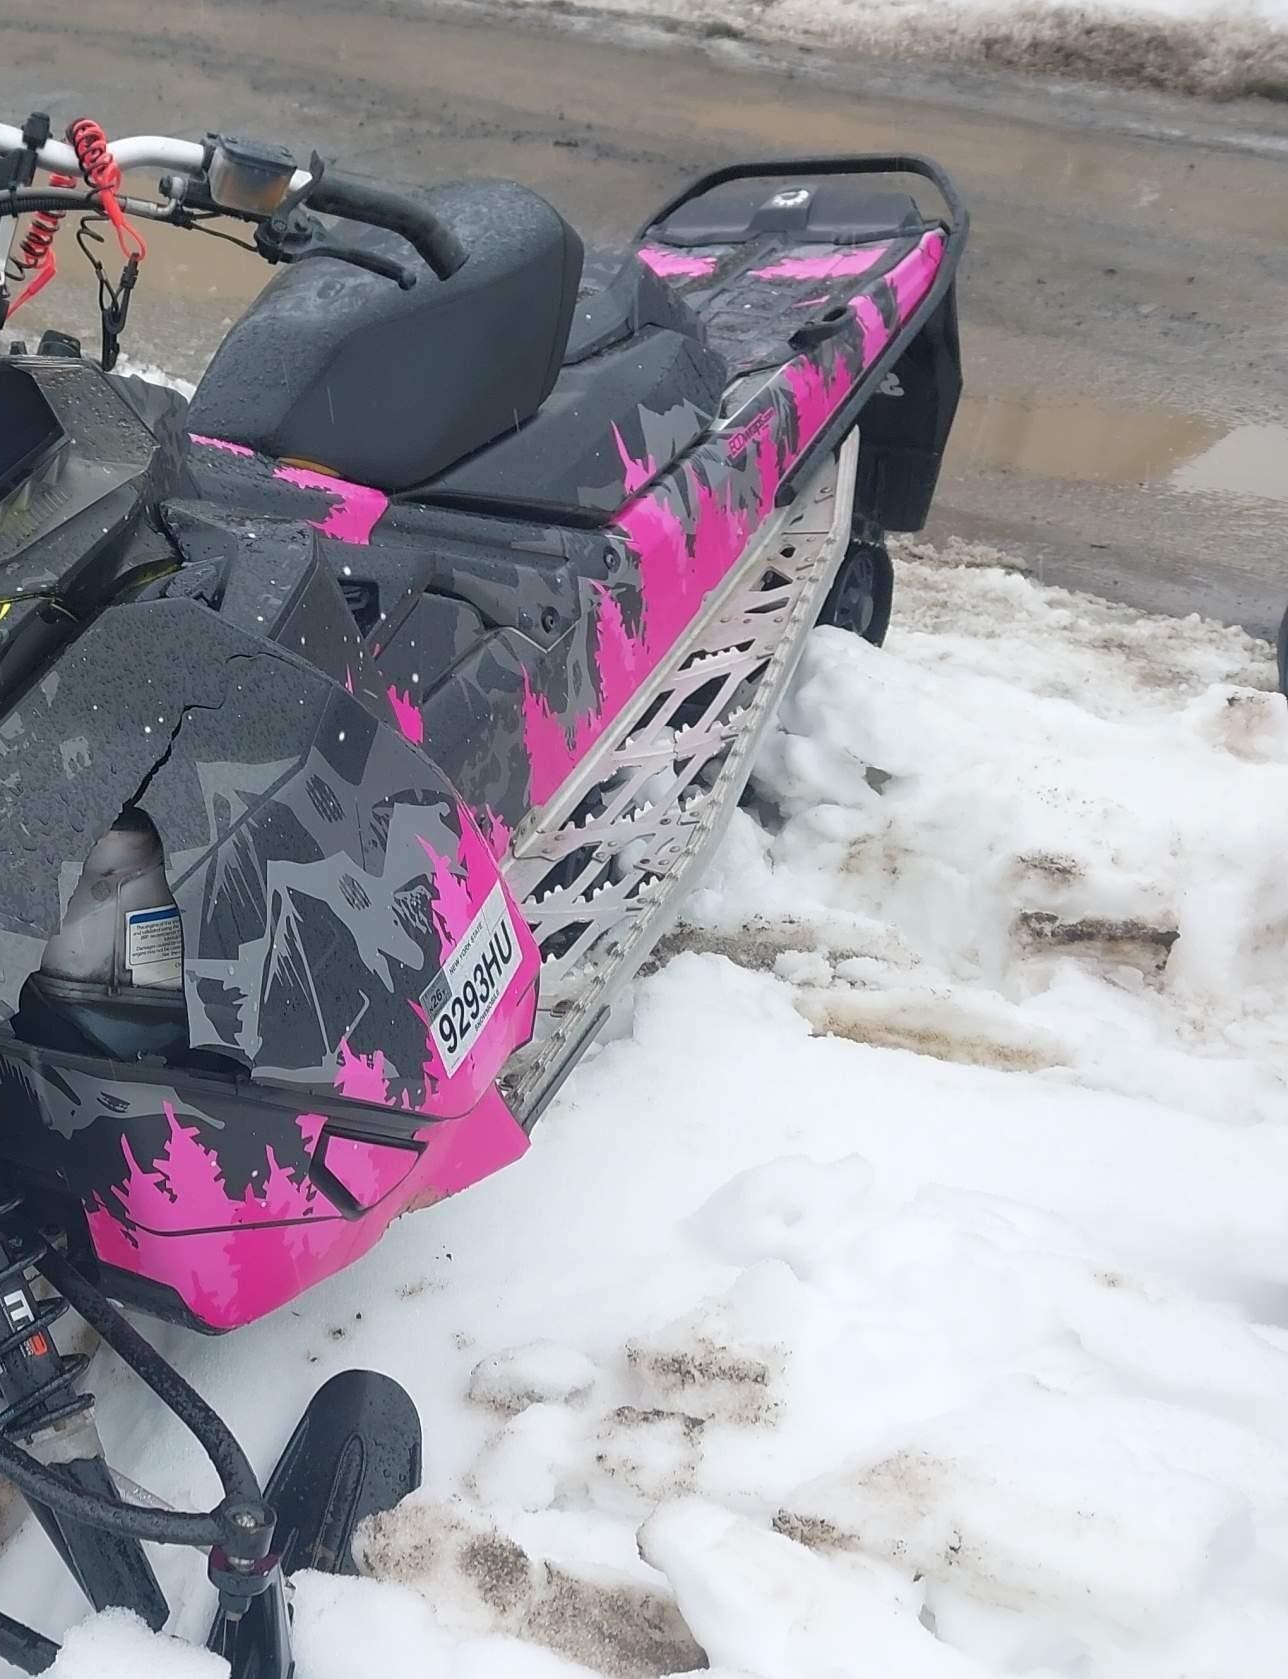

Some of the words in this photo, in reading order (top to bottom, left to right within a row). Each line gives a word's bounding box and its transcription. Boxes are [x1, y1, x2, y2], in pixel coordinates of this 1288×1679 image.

[439, 920, 512, 1053] 9293HU
[449, 960, 460, 976] NEW
[459, 942, 472, 960] YORK
[471, 922, 483, 943] STATE
